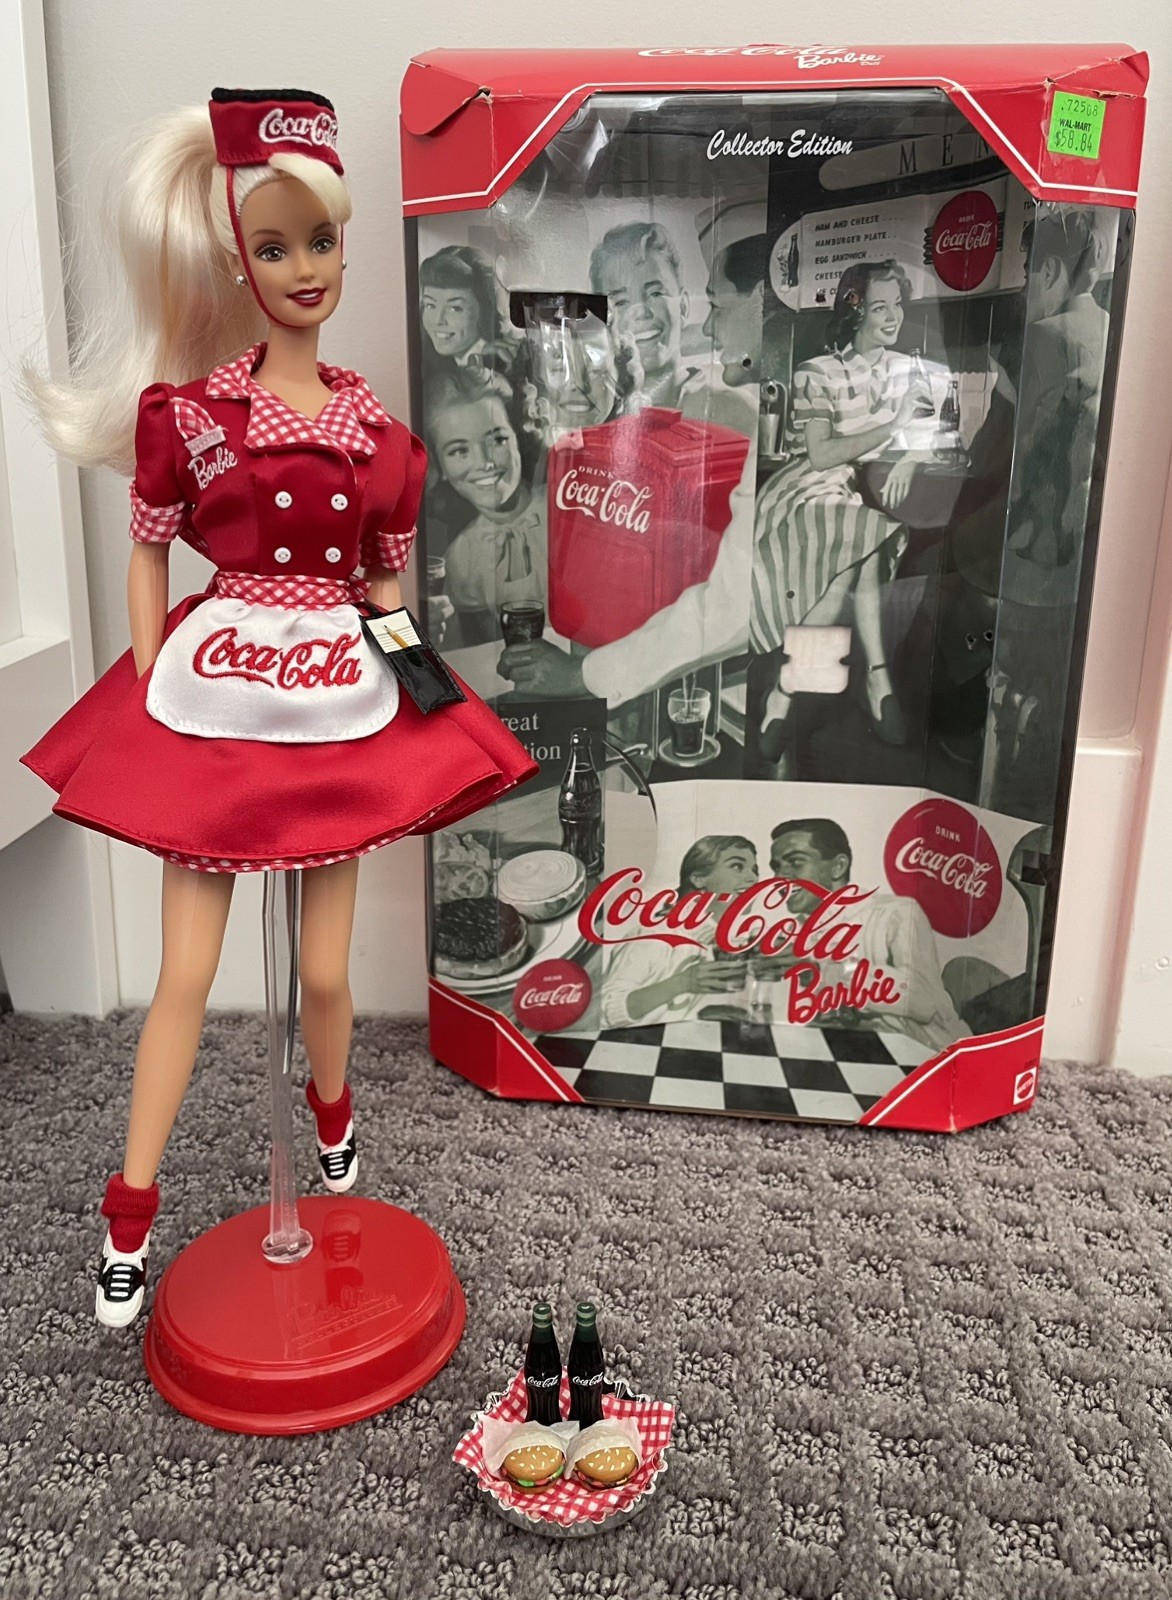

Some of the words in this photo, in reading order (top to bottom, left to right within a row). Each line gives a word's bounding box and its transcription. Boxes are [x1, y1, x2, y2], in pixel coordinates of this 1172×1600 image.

[794, 53, 881, 69] Barbie
[259, 108, 338, 148] Coca-Col
[1060, 118, 1091, 132] WAL-MART
[707, 130, 784, 160] Collector
[787, 129, 853, 158] Edition
[1055, 128, 1092, 152] $58.84
[815, 223, 831, 232] HAM
[833, 220, 848, 229] AND
[850, 215, 880, 226] CHEESE
[815, 235, 861, 247] HAMBURGER
[864, 232, 887, 241] PLATE
[936, 220, 993, 255] Coca-Cola
[832, 251, 867, 262] SANDWICH
[815, 271, 842, 280] CHEESE
[187, 446, 238, 490] Barbie
[578, 465, 615, 479] DRINK
[556, 469, 655, 533] Coca-Cola
[192, 627, 362, 690] Coca-Cola
[935, 825, 961, 842] DRINK
[895, 837, 993, 898] Coca-Cola
[578, 867, 880, 962] Coca-Cola
[783, 959, 901, 1024] Barbie
